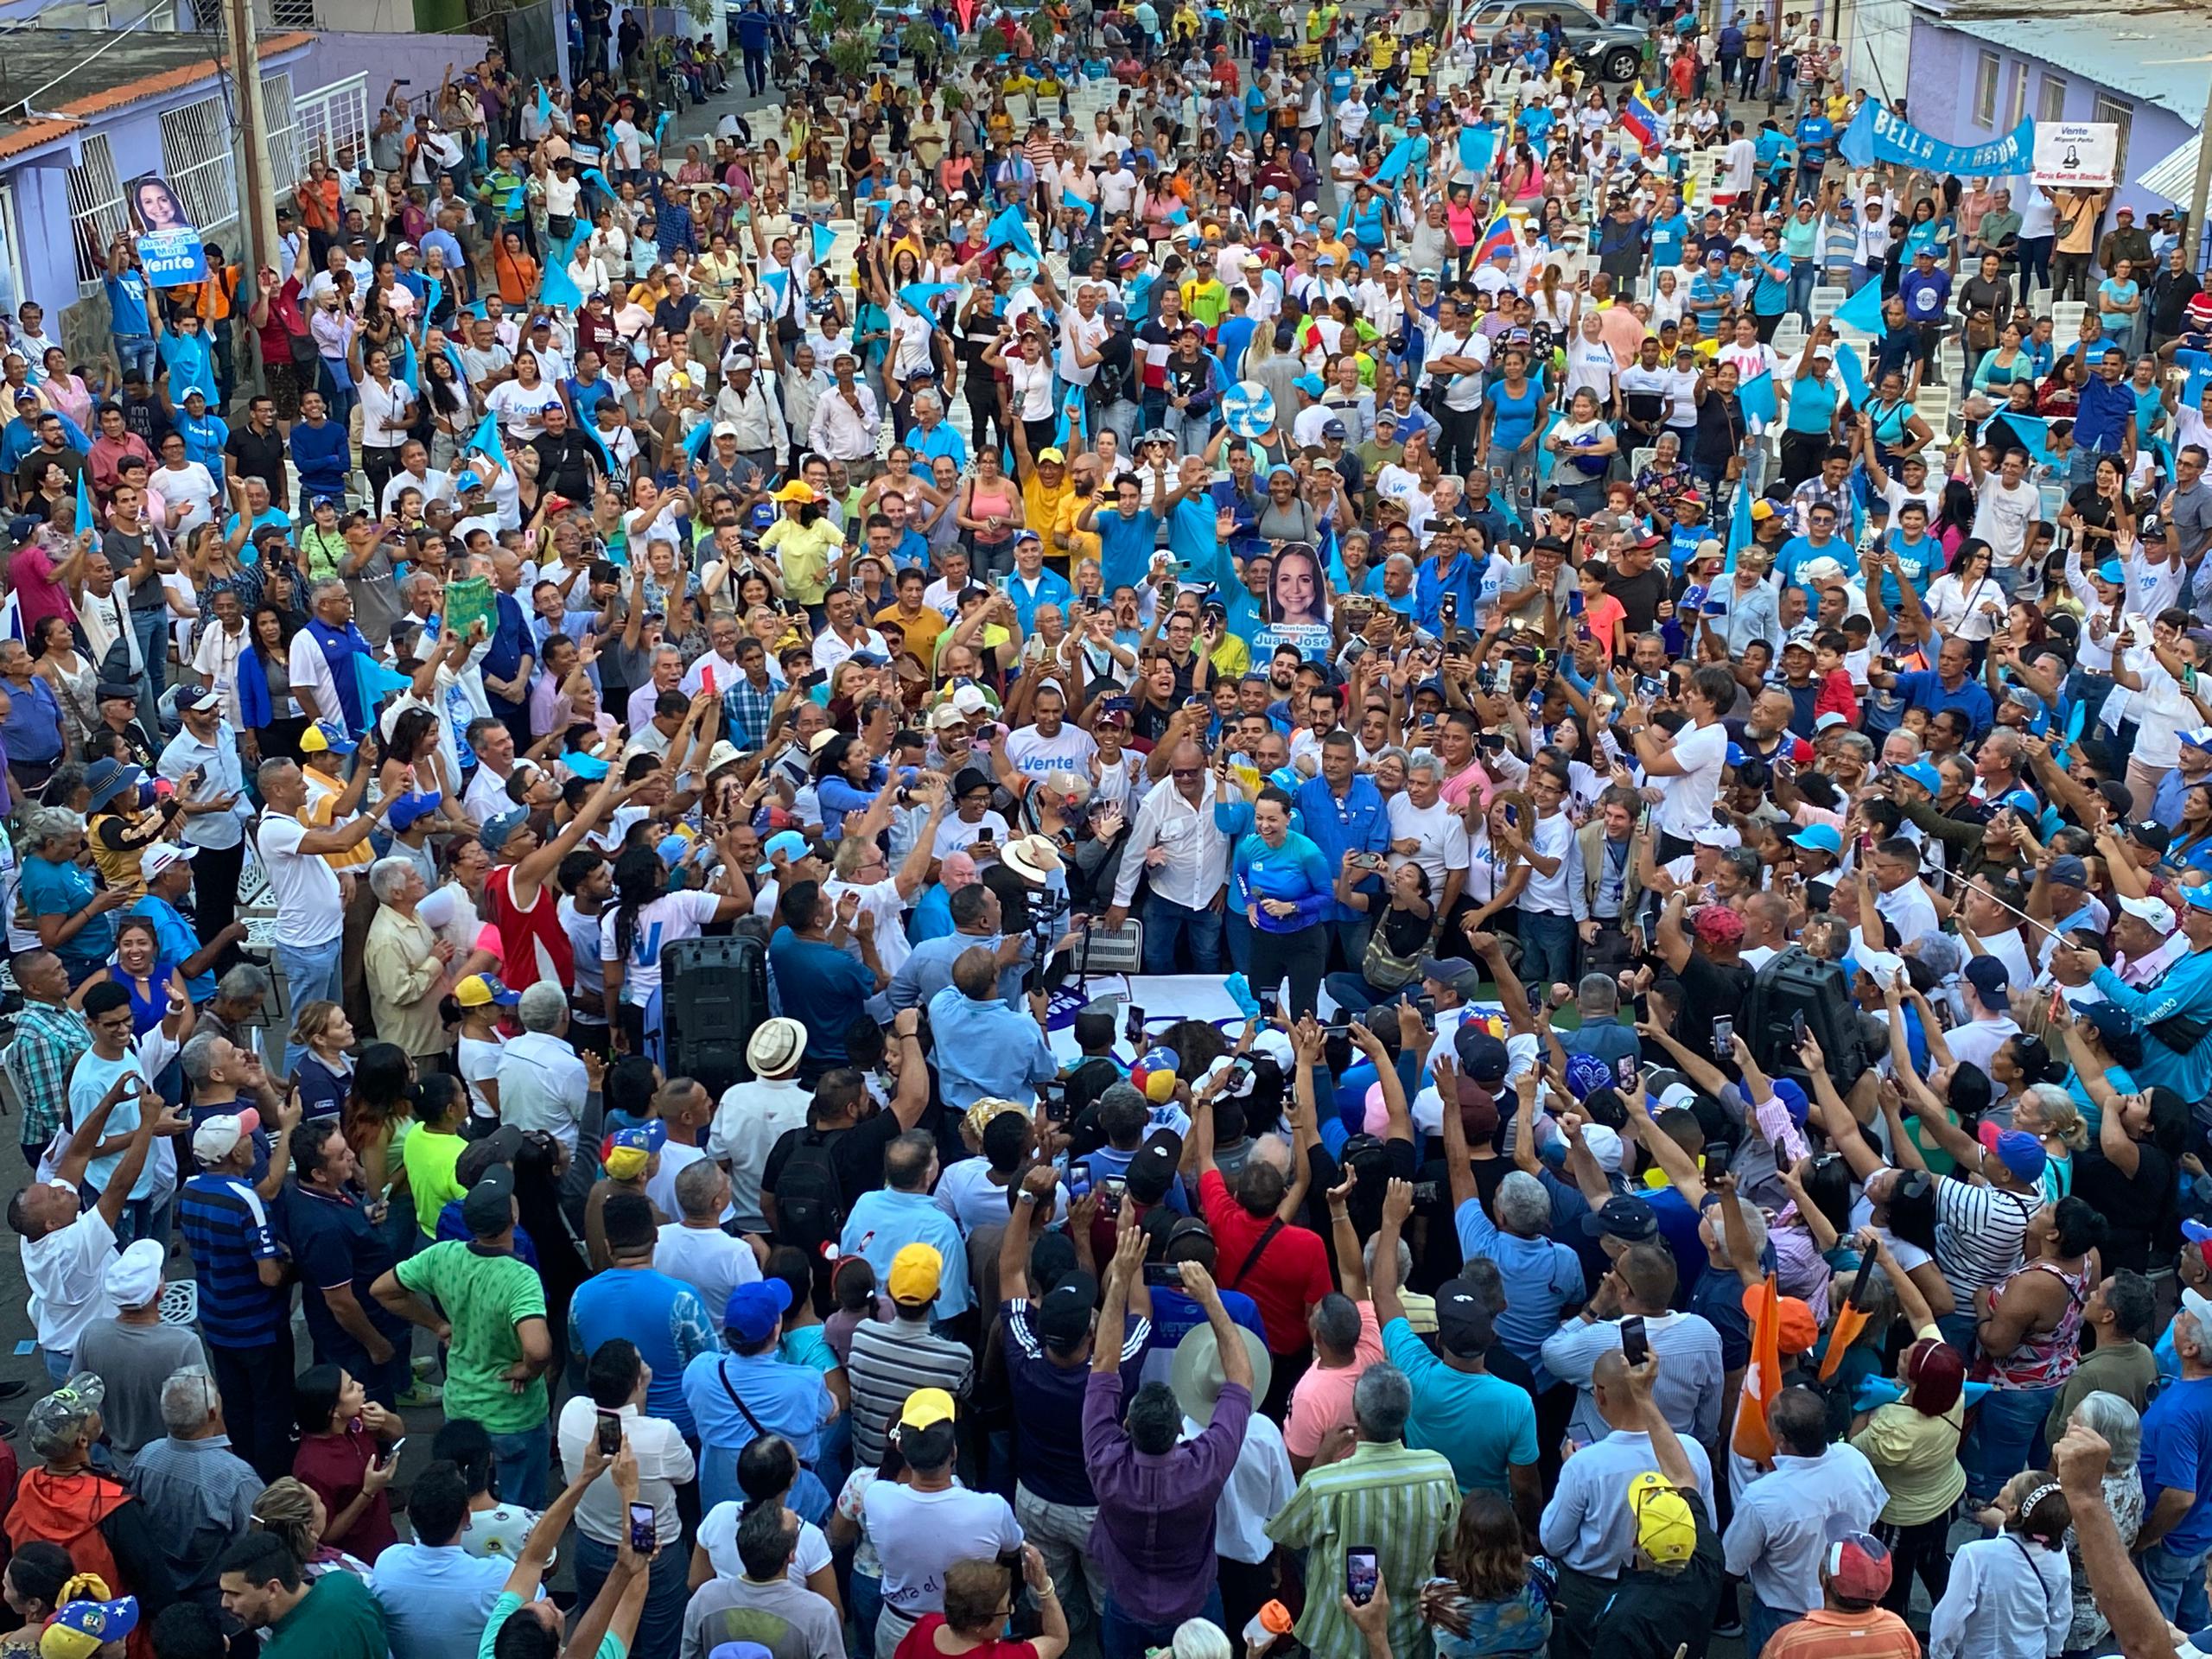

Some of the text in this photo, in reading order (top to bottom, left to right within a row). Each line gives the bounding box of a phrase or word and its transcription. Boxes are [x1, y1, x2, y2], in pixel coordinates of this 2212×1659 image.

[1873, 109, 1935, 160] BELLA
[141, 240, 167, 249] Juan
[141, 256, 195, 274] Vente
[514, 401, 544, 415] Vent
[188, 423, 214, 436] Vente
[1673, 534, 1700, 550] Vente
[1255, 633, 1331, 647] Juan José
[1024, 756, 1074, 771] Vente
[924, 1575, 939, 1593] el
